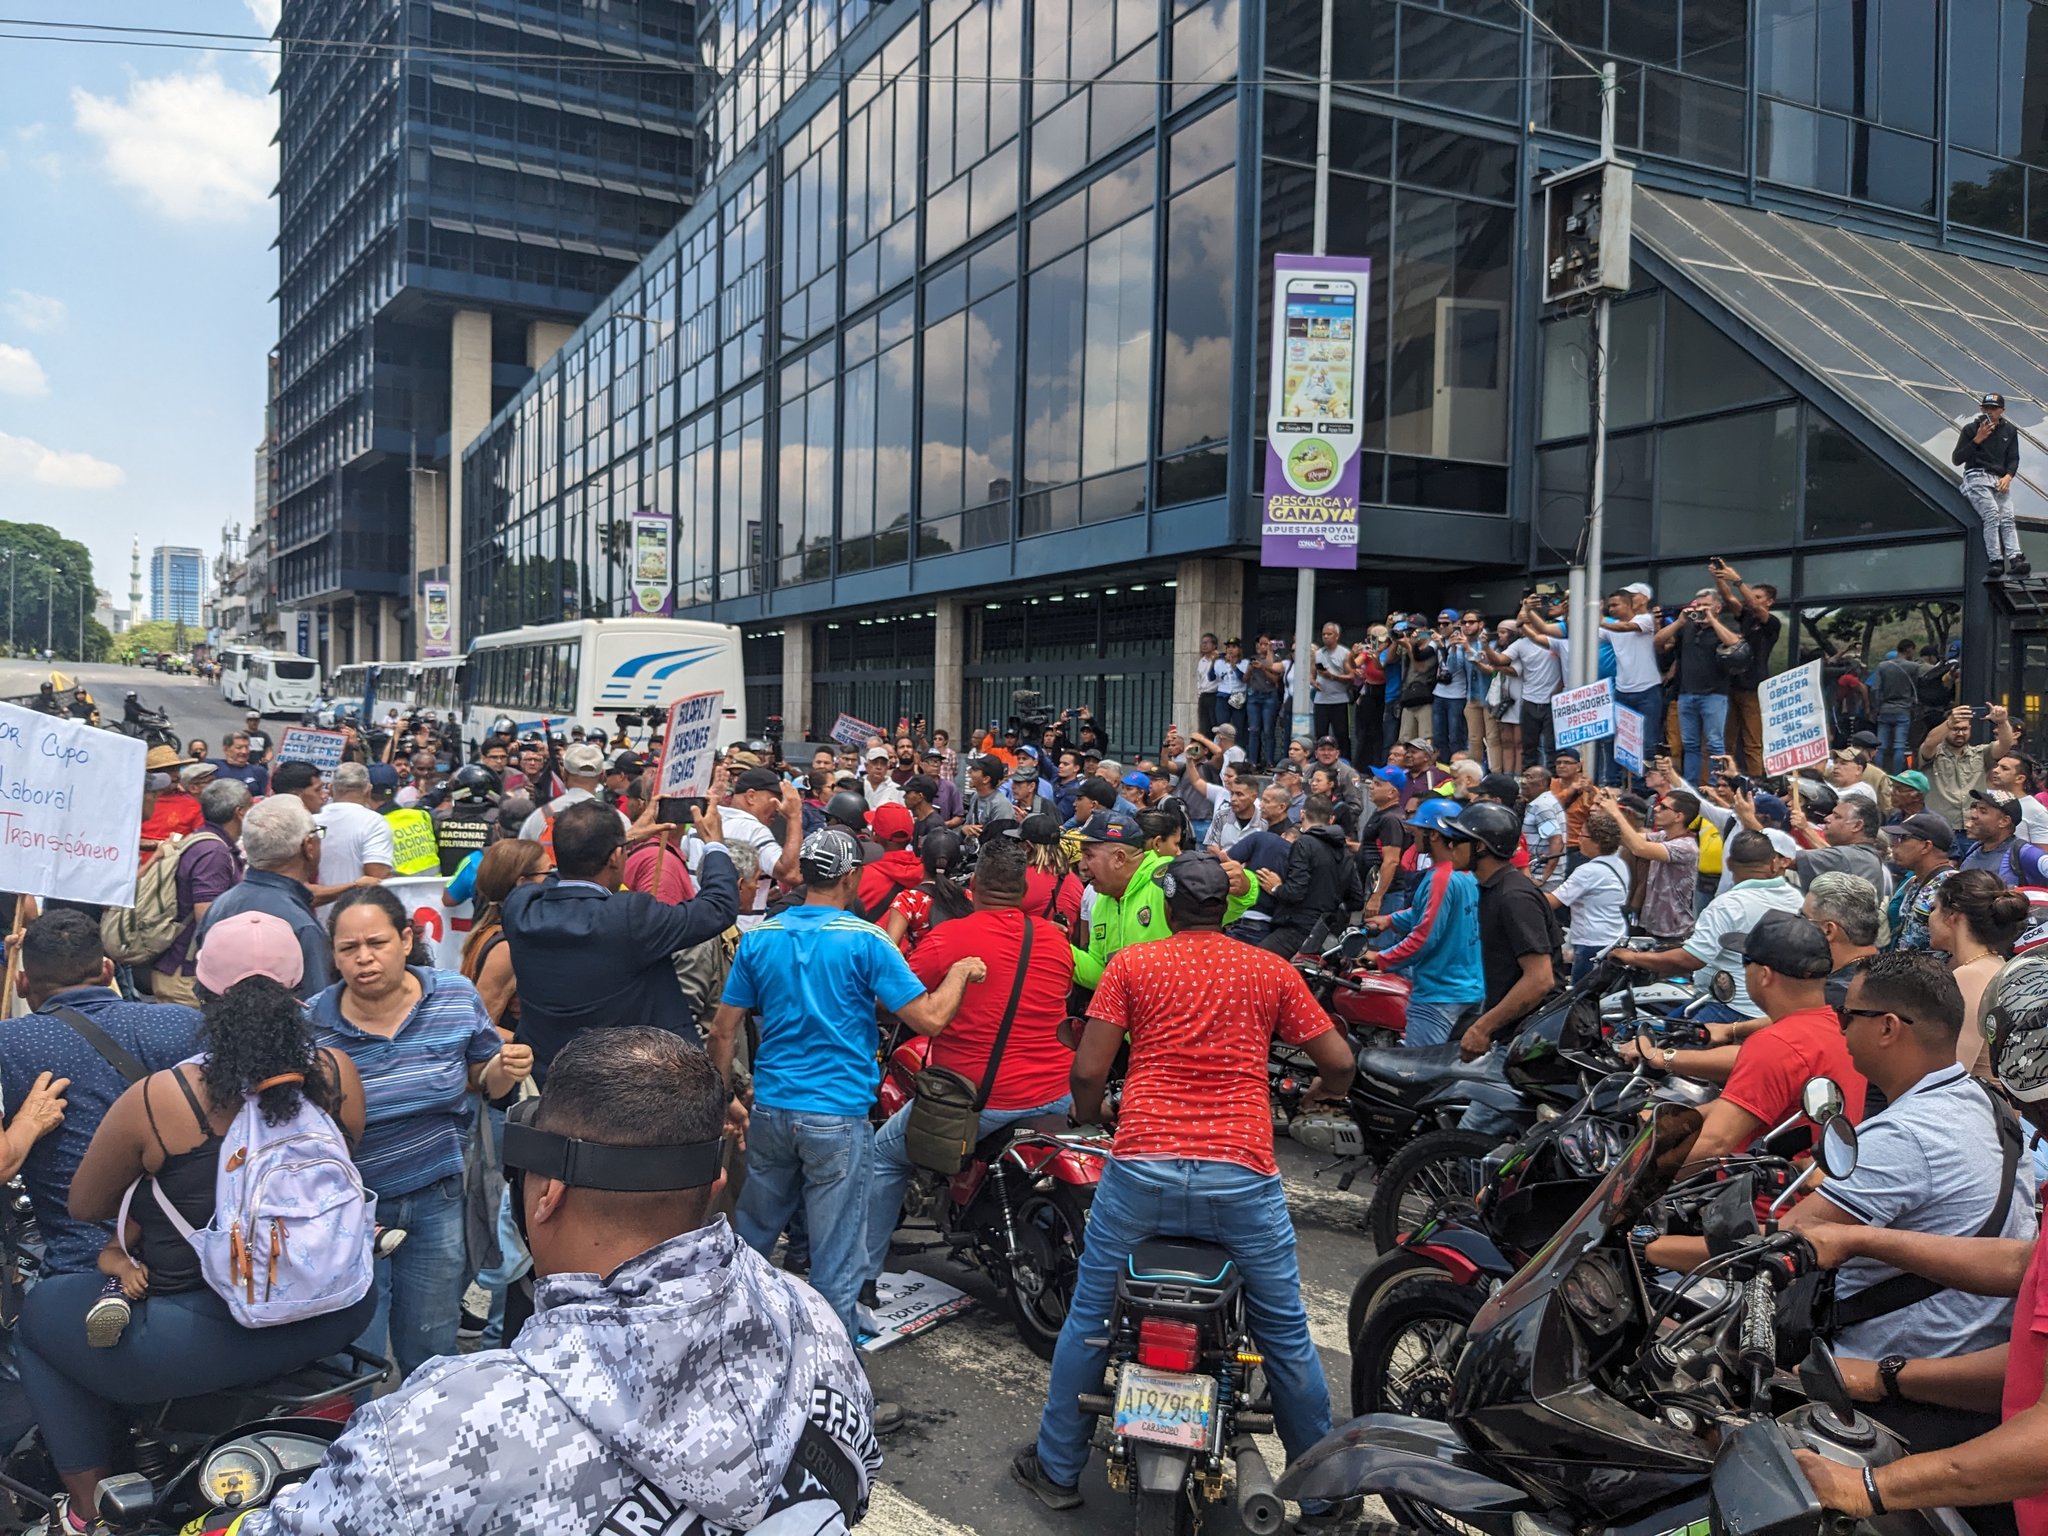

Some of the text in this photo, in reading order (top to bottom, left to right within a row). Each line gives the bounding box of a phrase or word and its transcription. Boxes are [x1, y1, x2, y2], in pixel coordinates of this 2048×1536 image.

[1272, 496, 1353, 508] DESCARGA Y
[1328, 508, 1356, 522] YA!
[1266, 526, 1355, 534] APUESTASROYAL
[1766, 667, 1809, 689] LA CLASE
[1561, 696, 1570, 704] DE
[1572, 687, 1592, 700] MAYO
[1593, 683, 1607, 694] SIN
[1769, 678, 1809, 700] OBRERA
[707, 696, 716, 719] Y
[1553, 694, 1611, 718] TRABAJADORES
[1771, 694, 1802, 712] UNIDA
[1568, 710, 1597, 727] PRESOS
[1782, 720, 1802, 734] SUS
[0, 722, 89, 768] OR Cupo
[290, 733, 342, 745] EL PACTO
[1768, 726, 1820, 752] DERECHOS
[284, 743, 341, 757] GOBIERNO
[1767, 740, 1826, 771] CUTV FNLCT
[0, 765, 74, 813] Laboral
[394, 822, 432, 839] OLICIA
[442, 822, 488, 830] POLICIA
[440, 831, 486, 839] NACIONAL
[2023, 927, 2044, 941] EDGE
